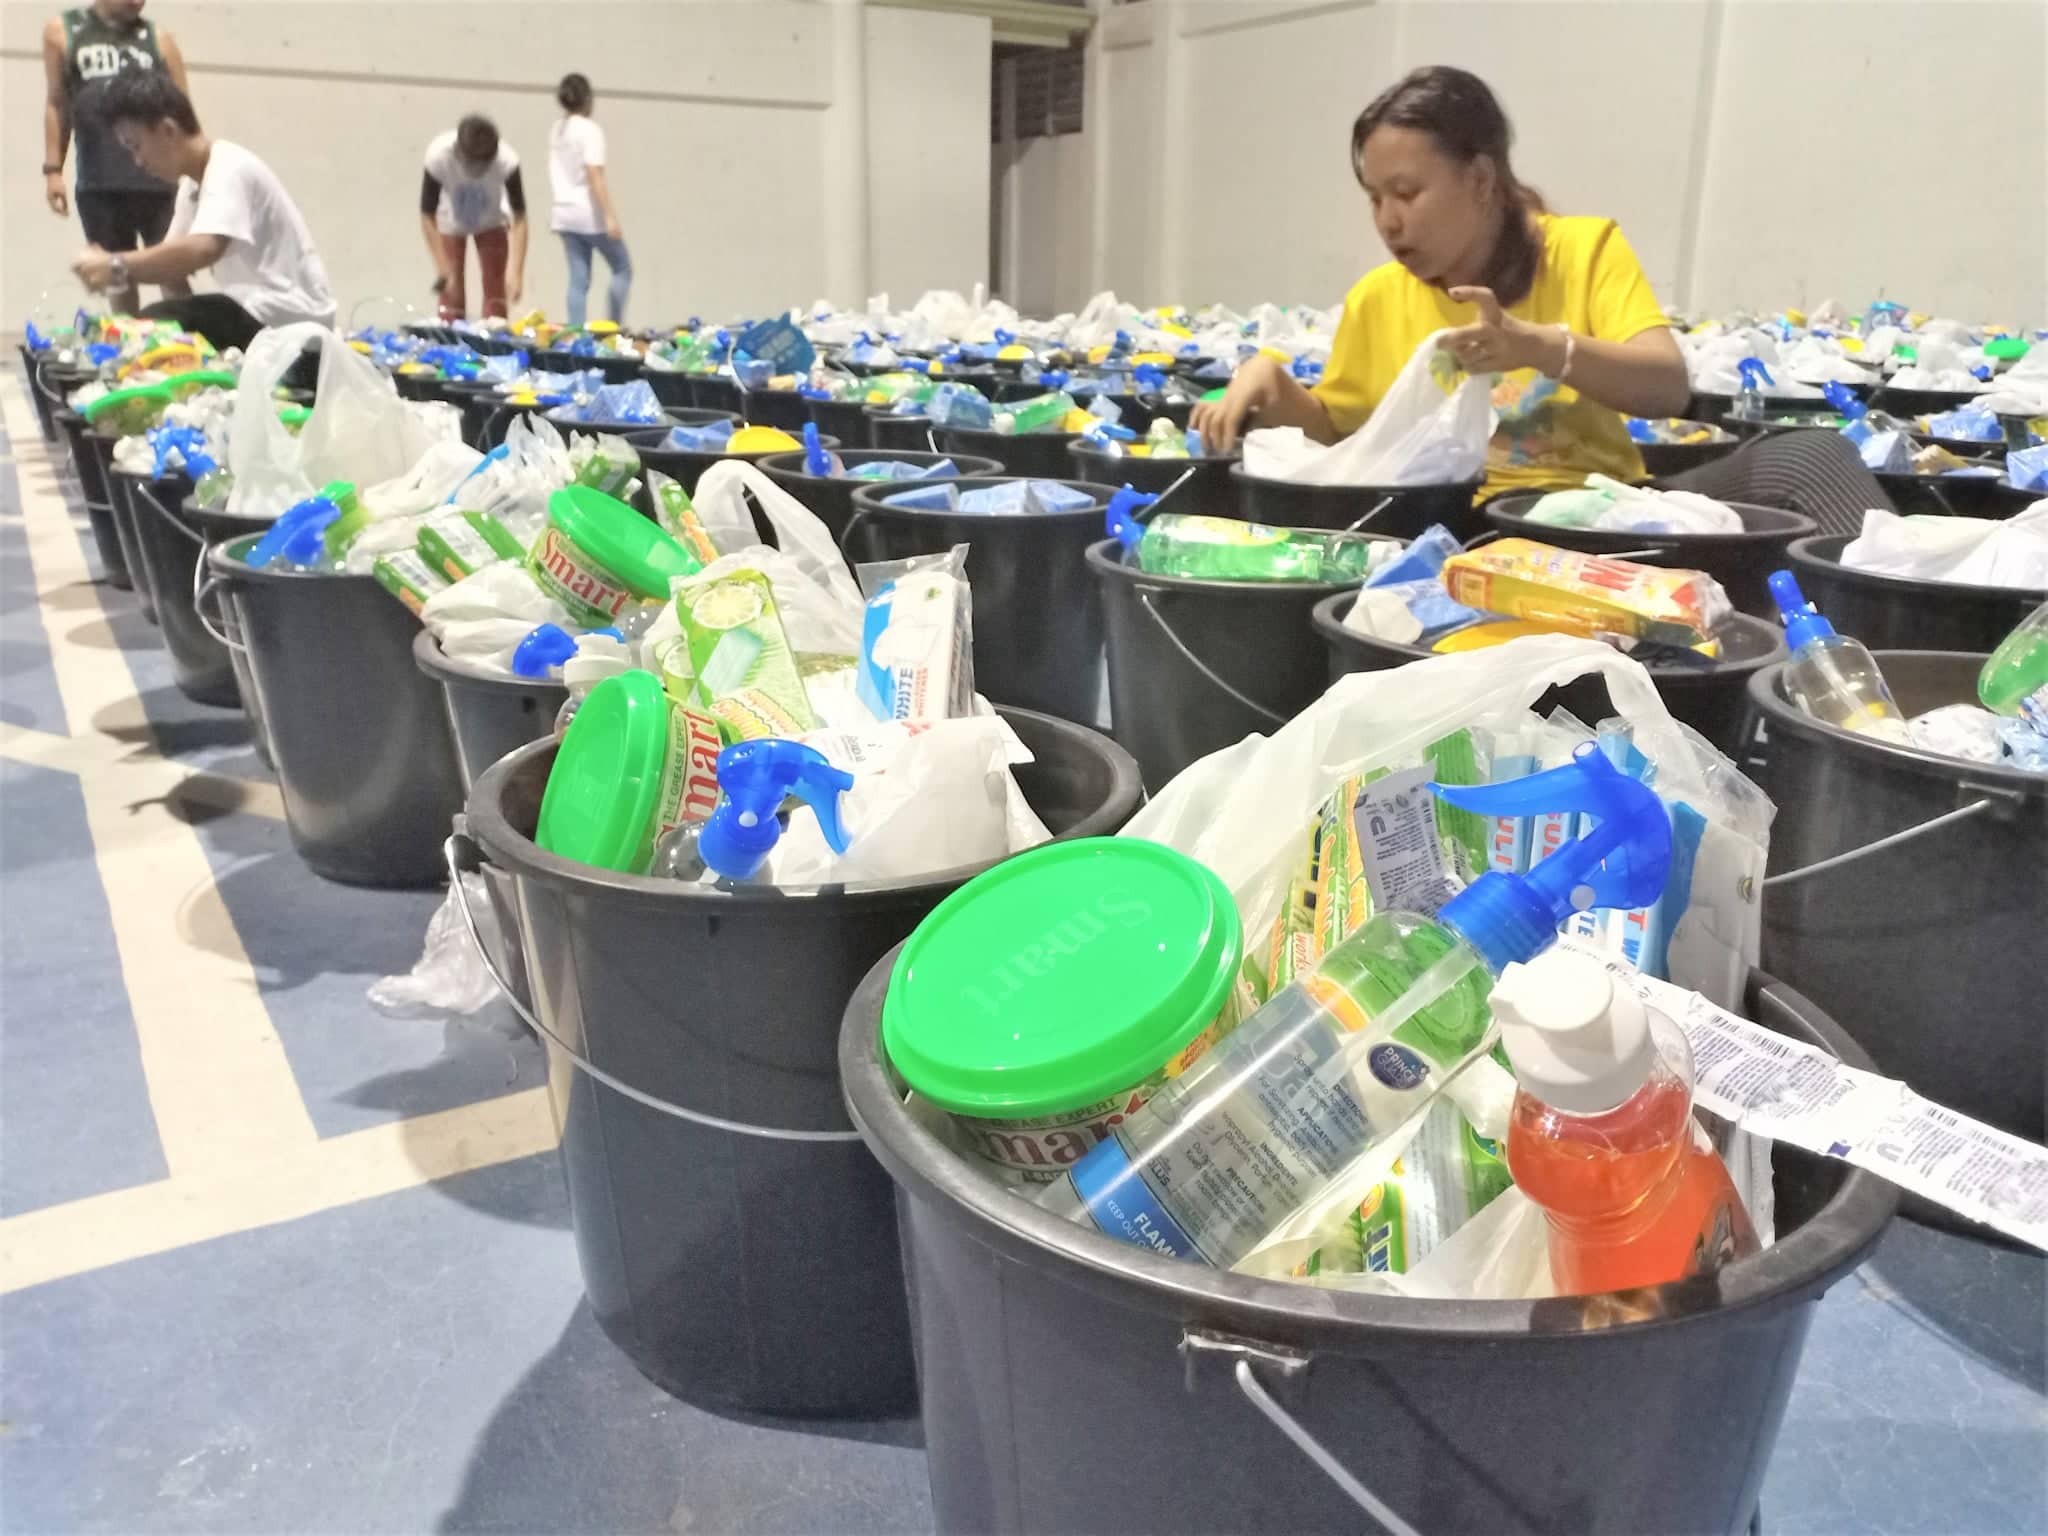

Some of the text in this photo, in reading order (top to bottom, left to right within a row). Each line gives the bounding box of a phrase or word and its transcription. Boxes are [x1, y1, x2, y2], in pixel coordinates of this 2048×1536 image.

[537, 528, 632, 617] Smart
[669, 750, 684, 795] GREASE
[663, 798, 676, 819] THE
[959, 884, 1151, 1016] Smart
[1295, 934, 1312, 970] works
[1383, 1046, 1416, 1083] PRINCE
[1104, 1199, 1125, 1222] KEEP
[1120, 1218, 1140, 1240] OUT
